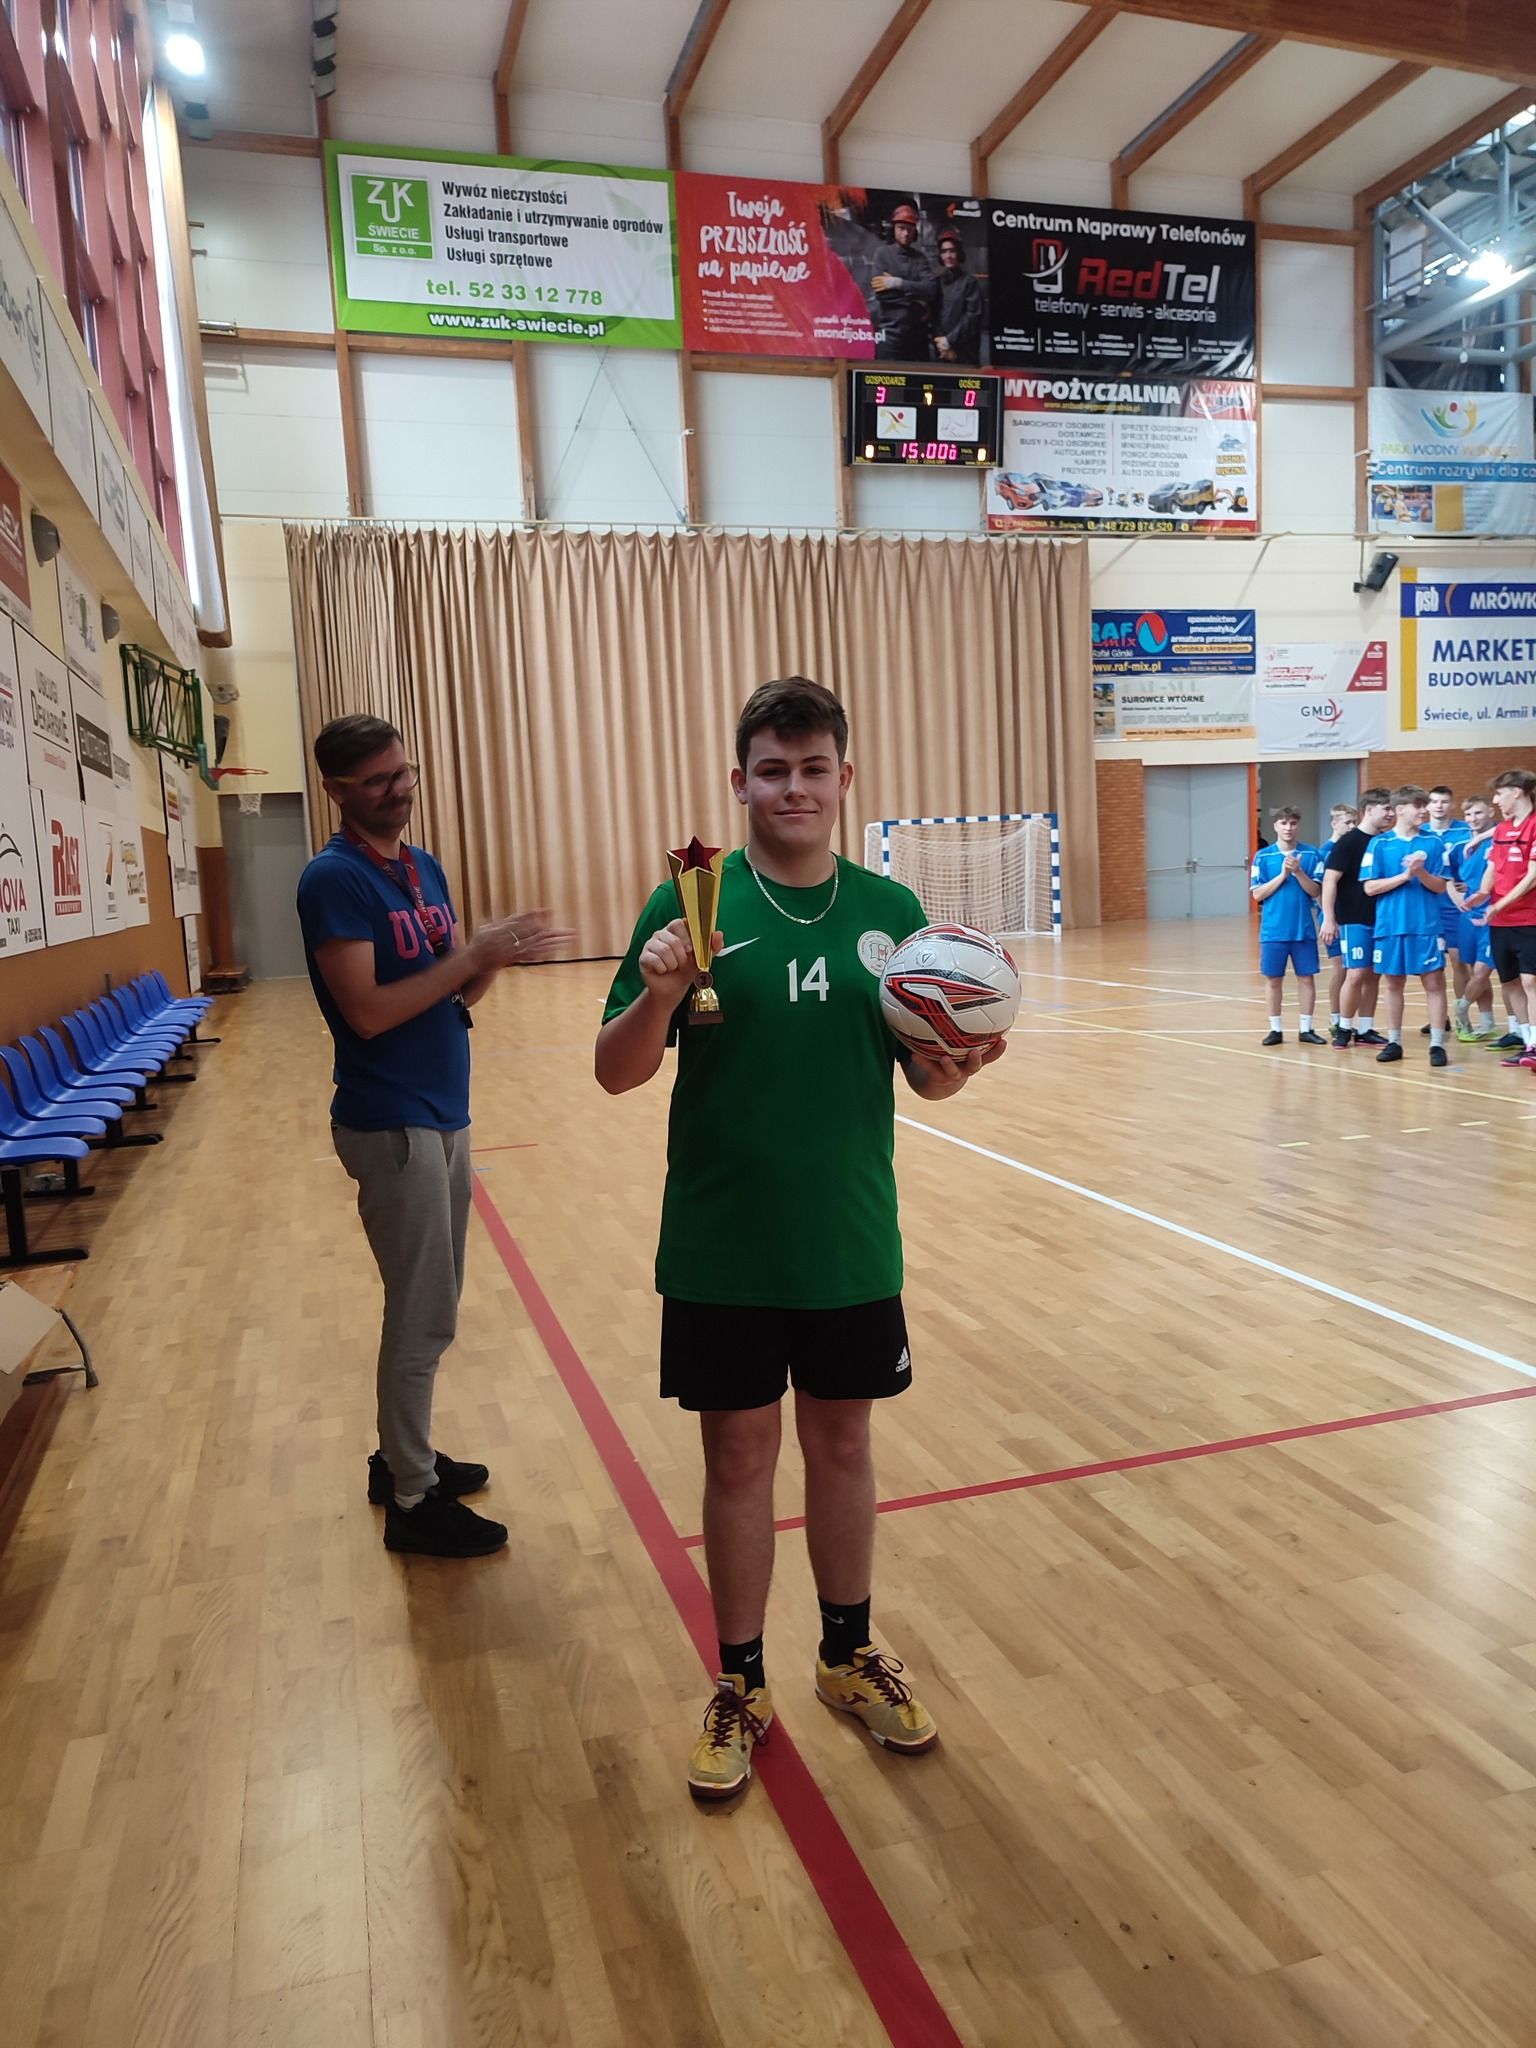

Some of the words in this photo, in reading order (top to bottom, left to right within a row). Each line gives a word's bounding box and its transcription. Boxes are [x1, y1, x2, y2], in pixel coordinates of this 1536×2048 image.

[442, 181, 487, 198] Wywóz
[491, 186, 568, 205] nieczystości
[443, 203, 513, 222] Zakładanie
[517, 209, 521, 223] i
[525, 212, 609, 230] utrzymywanie
[612, 218, 663, 234] ogrodów
[727, 191, 785, 225] Twoja
[368, 222, 419, 240] ŚWIECIE
[445, 225, 484, 242] Usługi
[488, 229, 568, 248] transportowe
[700, 221, 809, 256] PRZYSZŁOŚĆ
[992, 210, 1073, 233] Centrum
[1077, 219, 1157, 243] Naprawy
[1160, 224, 1246, 247] Telefonów
[447, 247, 486, 264] Usługi
[490, 252, 553, 269] sprzętowe
[698, 259, 725, 279] na
[730, 257, 811, 285] papierze
[1077, 257, 1221, 304] RedTel
[426, 279, 461, 297] tel.
[468, 282, 494, 299] 52
[502, 284, 526, 301] 33
[535, 287, 559, 303] 12
[565, 288, 603, 306] 778
[1035, 297, 1090, 319] telefony
[1100, 302, 1144, 319] serwis
[1154, 305, 1217, 324] akcesoria
[428, 312, 604, 338] www.zuk-swiecie.pl
[814, 328, 886, 344] mondijobs.pl
[864, 375, 907, 386] GOSPODARZE
[1003, 377, 1181, 405] WYPOŻYCZALNIA
[875, 386, 887, 404] 3
[964, 390, 976, 407] 0
[1377, 462, 1436, 476] Centrum
[1432, 639, 1536, 662] MARKET
[1428, 670, 1536, 687] BUDOWLANY
[1121, 695, 1165, 704] SUROWCE
[1167, 693, 1205, 703] WTÓRNE
[1300, 705, 1334, 717] GMD
[1423, 706, 1473, 722] Świecie,
[1476, 706, 1492, 720] ul.
[1496, 706, 1529, 719] Armii
[0, 878, 27, 913] OVA
[1351, 946, 1364, 960] 10
[785, 956, 830, 1002] 14
